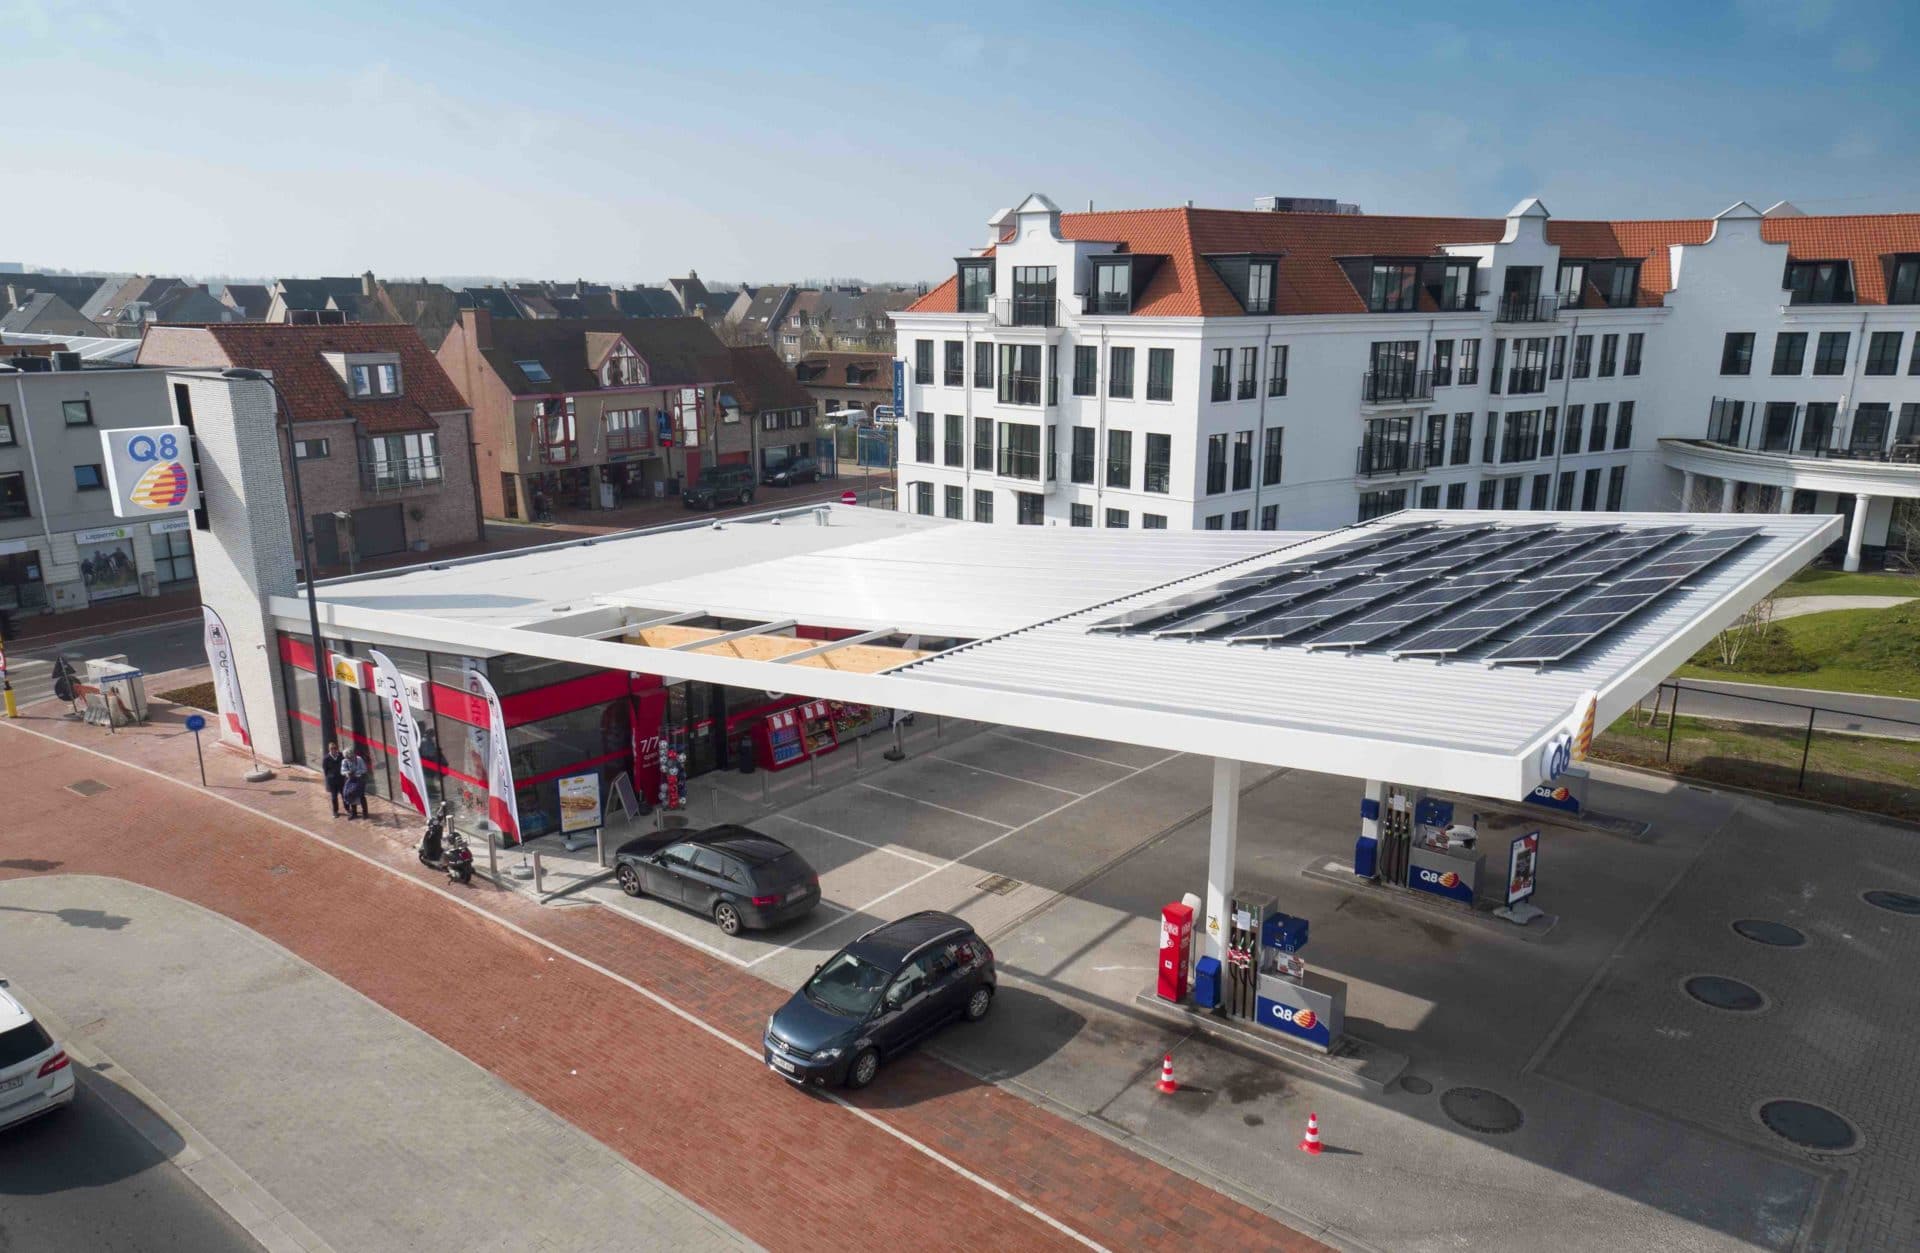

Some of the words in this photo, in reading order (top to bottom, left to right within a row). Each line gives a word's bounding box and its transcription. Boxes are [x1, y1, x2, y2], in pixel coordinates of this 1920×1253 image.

[128, 434, 179, 462] Q8
[640, 736, 659, 753] 7/7
[1550, 735, 1572, 781] Q8
[1535, 786, 1551, 798] Q8
[1420, 870, 1438, 883] Q8
[1272, 1004, 1293, 1022] Q8
